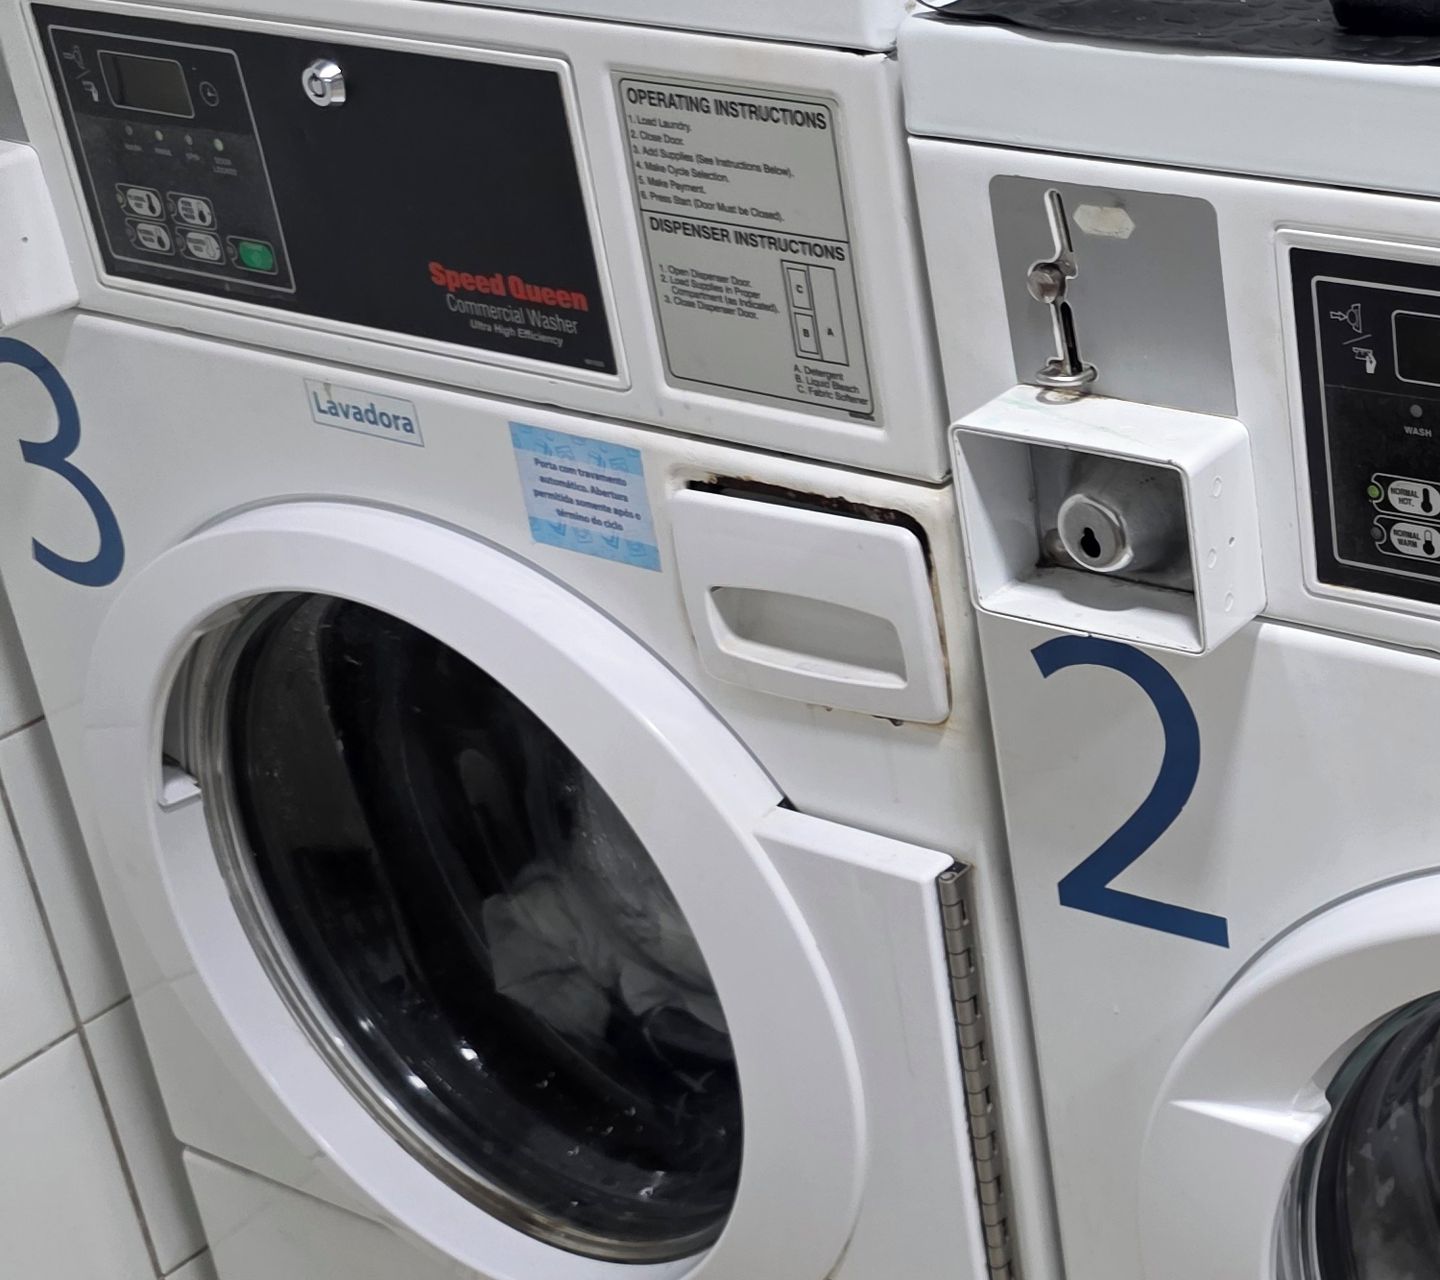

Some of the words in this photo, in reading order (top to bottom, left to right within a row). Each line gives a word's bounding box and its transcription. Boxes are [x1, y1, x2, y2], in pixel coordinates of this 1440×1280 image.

[626, 86, 711, 114] OPERATING
[713, 98, 827, 130] INSTRUCTIONS
[648, 215, 732, 242] DISPENSER
[733, 230, 845, 261] INSTRUCTIONS
[428, 262, 506, 295] Speed
[509, 276, 588, 311] Queen
[445, 292, 525, 324] Commercial
[525, 308, 578, 334] Washer
[312, 392, 415, 434] Lavadora
[1403, 425, 1432, 437] WASH
[0, 336, 125, 588] 3
[1030, 634, 1230, 949] 2
